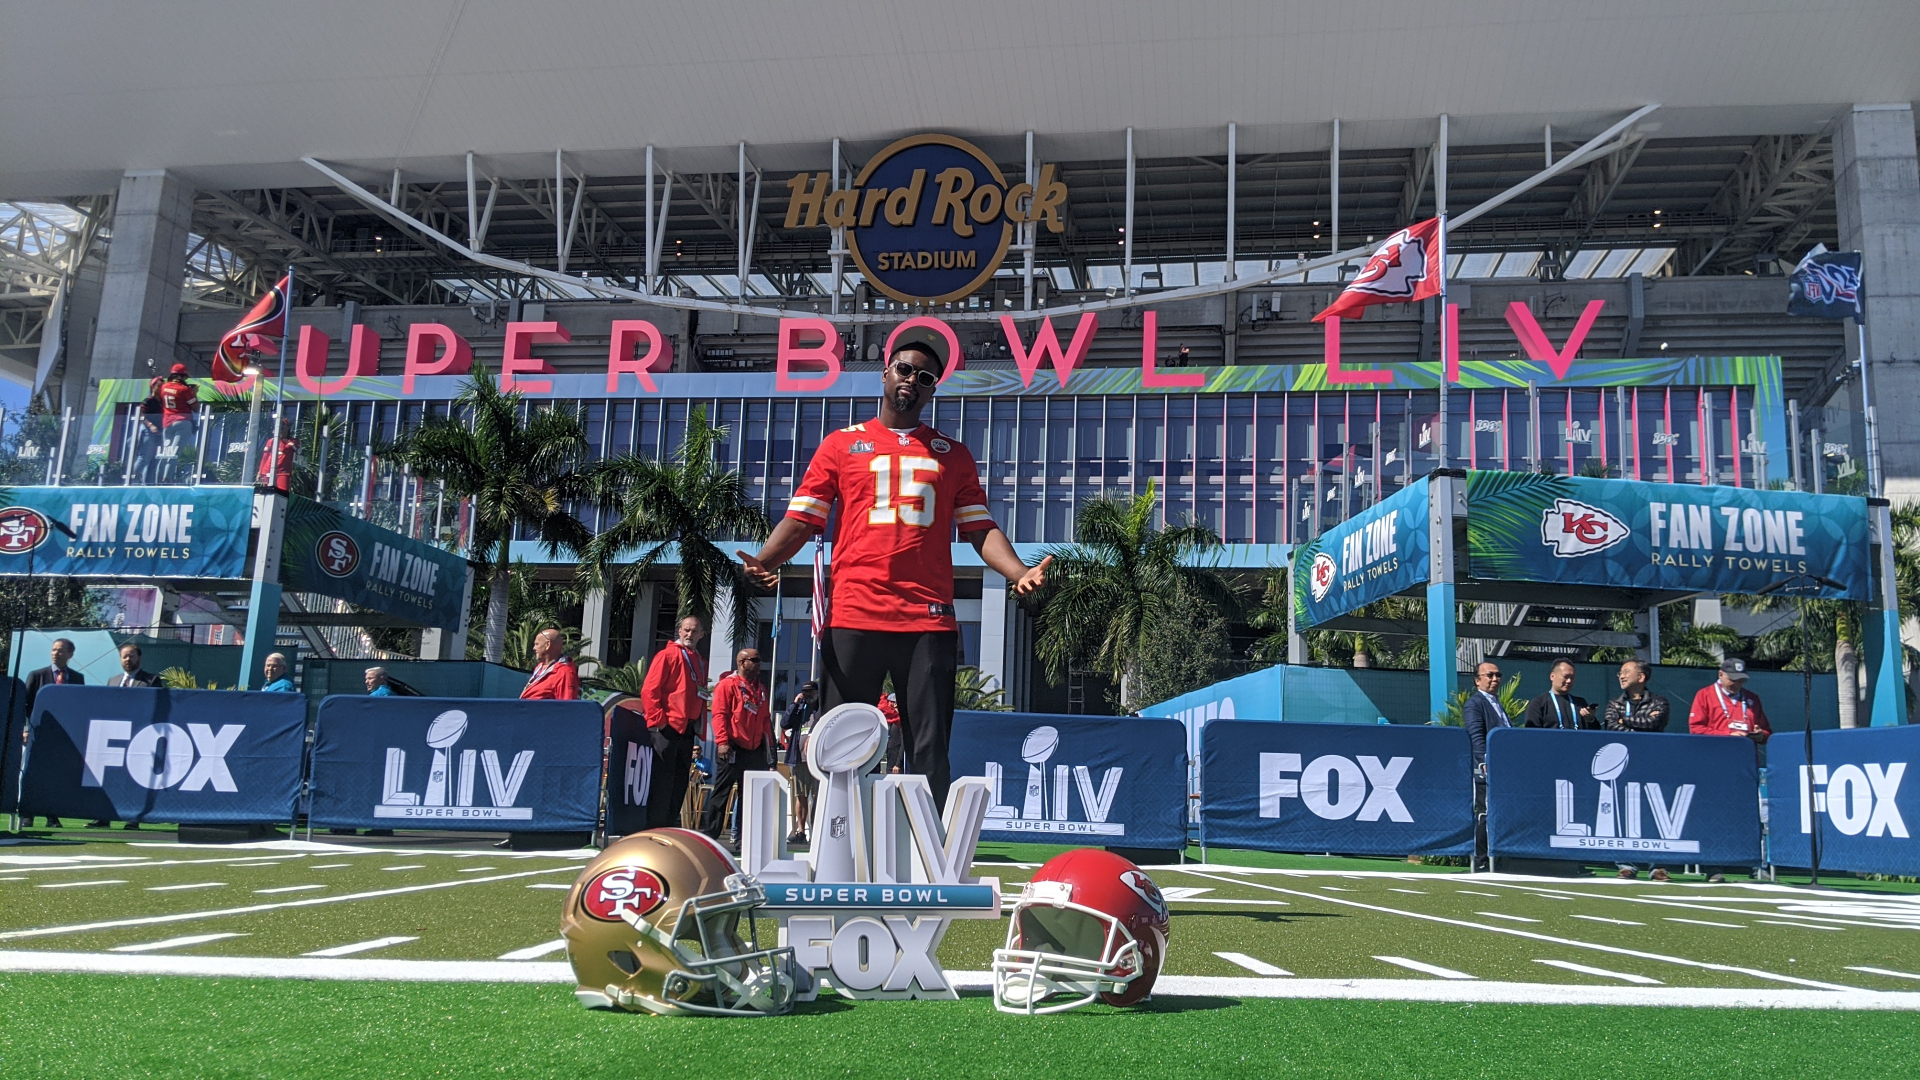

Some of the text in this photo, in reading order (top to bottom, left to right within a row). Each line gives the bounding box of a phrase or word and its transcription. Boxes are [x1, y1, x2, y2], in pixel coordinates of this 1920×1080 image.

[783, 163, 1068, 238] Hard Rock
[877, 250, 977, 271] STADIUM
[775, 311, 1206, 392] BOWL
[1324, 299, 1606, 383] LIV
[164, 394, 177, 409] 15
[868, 454, 940, 528] 15
[68, 504, 194, 543] FAN ZONE
[1342, 510, 1398, 576] FAN ZONE
[1562, 512, 1608, 544] KC
[1650, 501, 1806, 555] FAN ZONE
[66, 547, 190, 560] RALLY TOWELS
[369, 541, 439, 596] FAN ZONE
[1343, 557, 1398, 592] RALLY TOWELS
[1651, 553, 1807, 574] RALLY TOWELS
[365, 580, 433, 610] RALLY TOWELS
[81, 719, 246, 793] FOX
[382, 747, 535, 807] LIV
[405, 808, 502, 817] SUPER BOWL
[1259, 752, 1415, 823] FOX
[1555, 779, 1696, 840] LIV
[1799, 762, 1911, 839] FOX
[743, 770, 996, 886] LIV
[1006, 821, 1096, 832] SUPER BOWL
[1579, 838, 1671, 849] SUPER BOWL
[785, 888, 948, 903] SUPER BOWL
[787, 915, 948, 994] FOX
